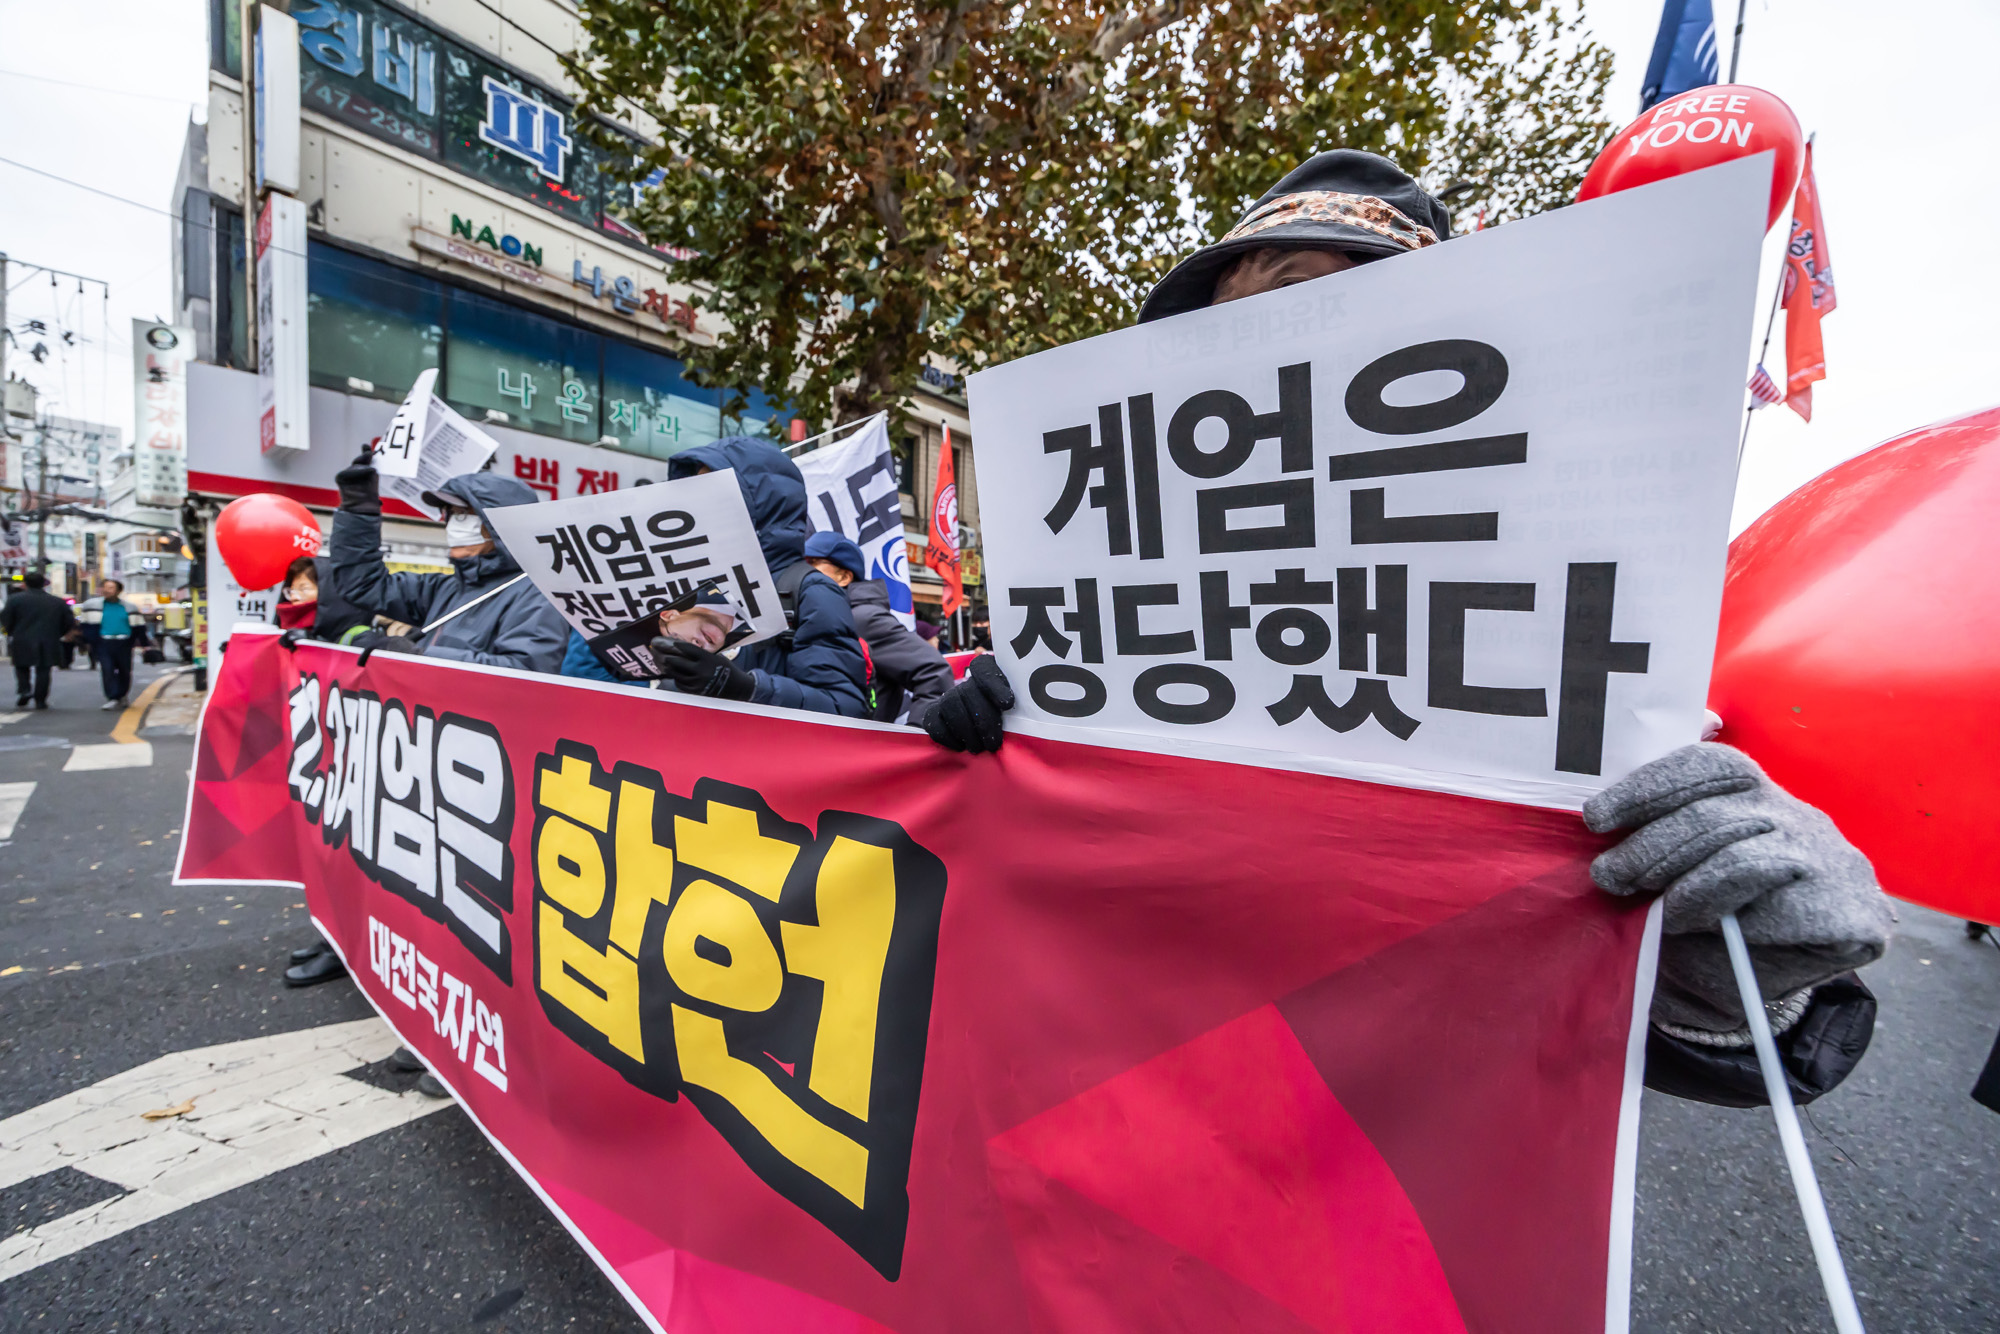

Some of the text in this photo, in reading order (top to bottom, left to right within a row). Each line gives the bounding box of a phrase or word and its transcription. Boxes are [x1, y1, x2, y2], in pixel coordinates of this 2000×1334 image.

[1629, 116, 1754, 157] YOON
[1650, 94, 1750, 125] FREE
[451, 213, 543, 266] NAON
[1043, 338, 1529, 560] 계엄은
[535, 509, 710, 584] 계엄은
[1009, 562, 1651, 776] 정당했다
[369, 915, 508, 1093] 대전국자연
[537, 754, 896, 1210] 합헌
